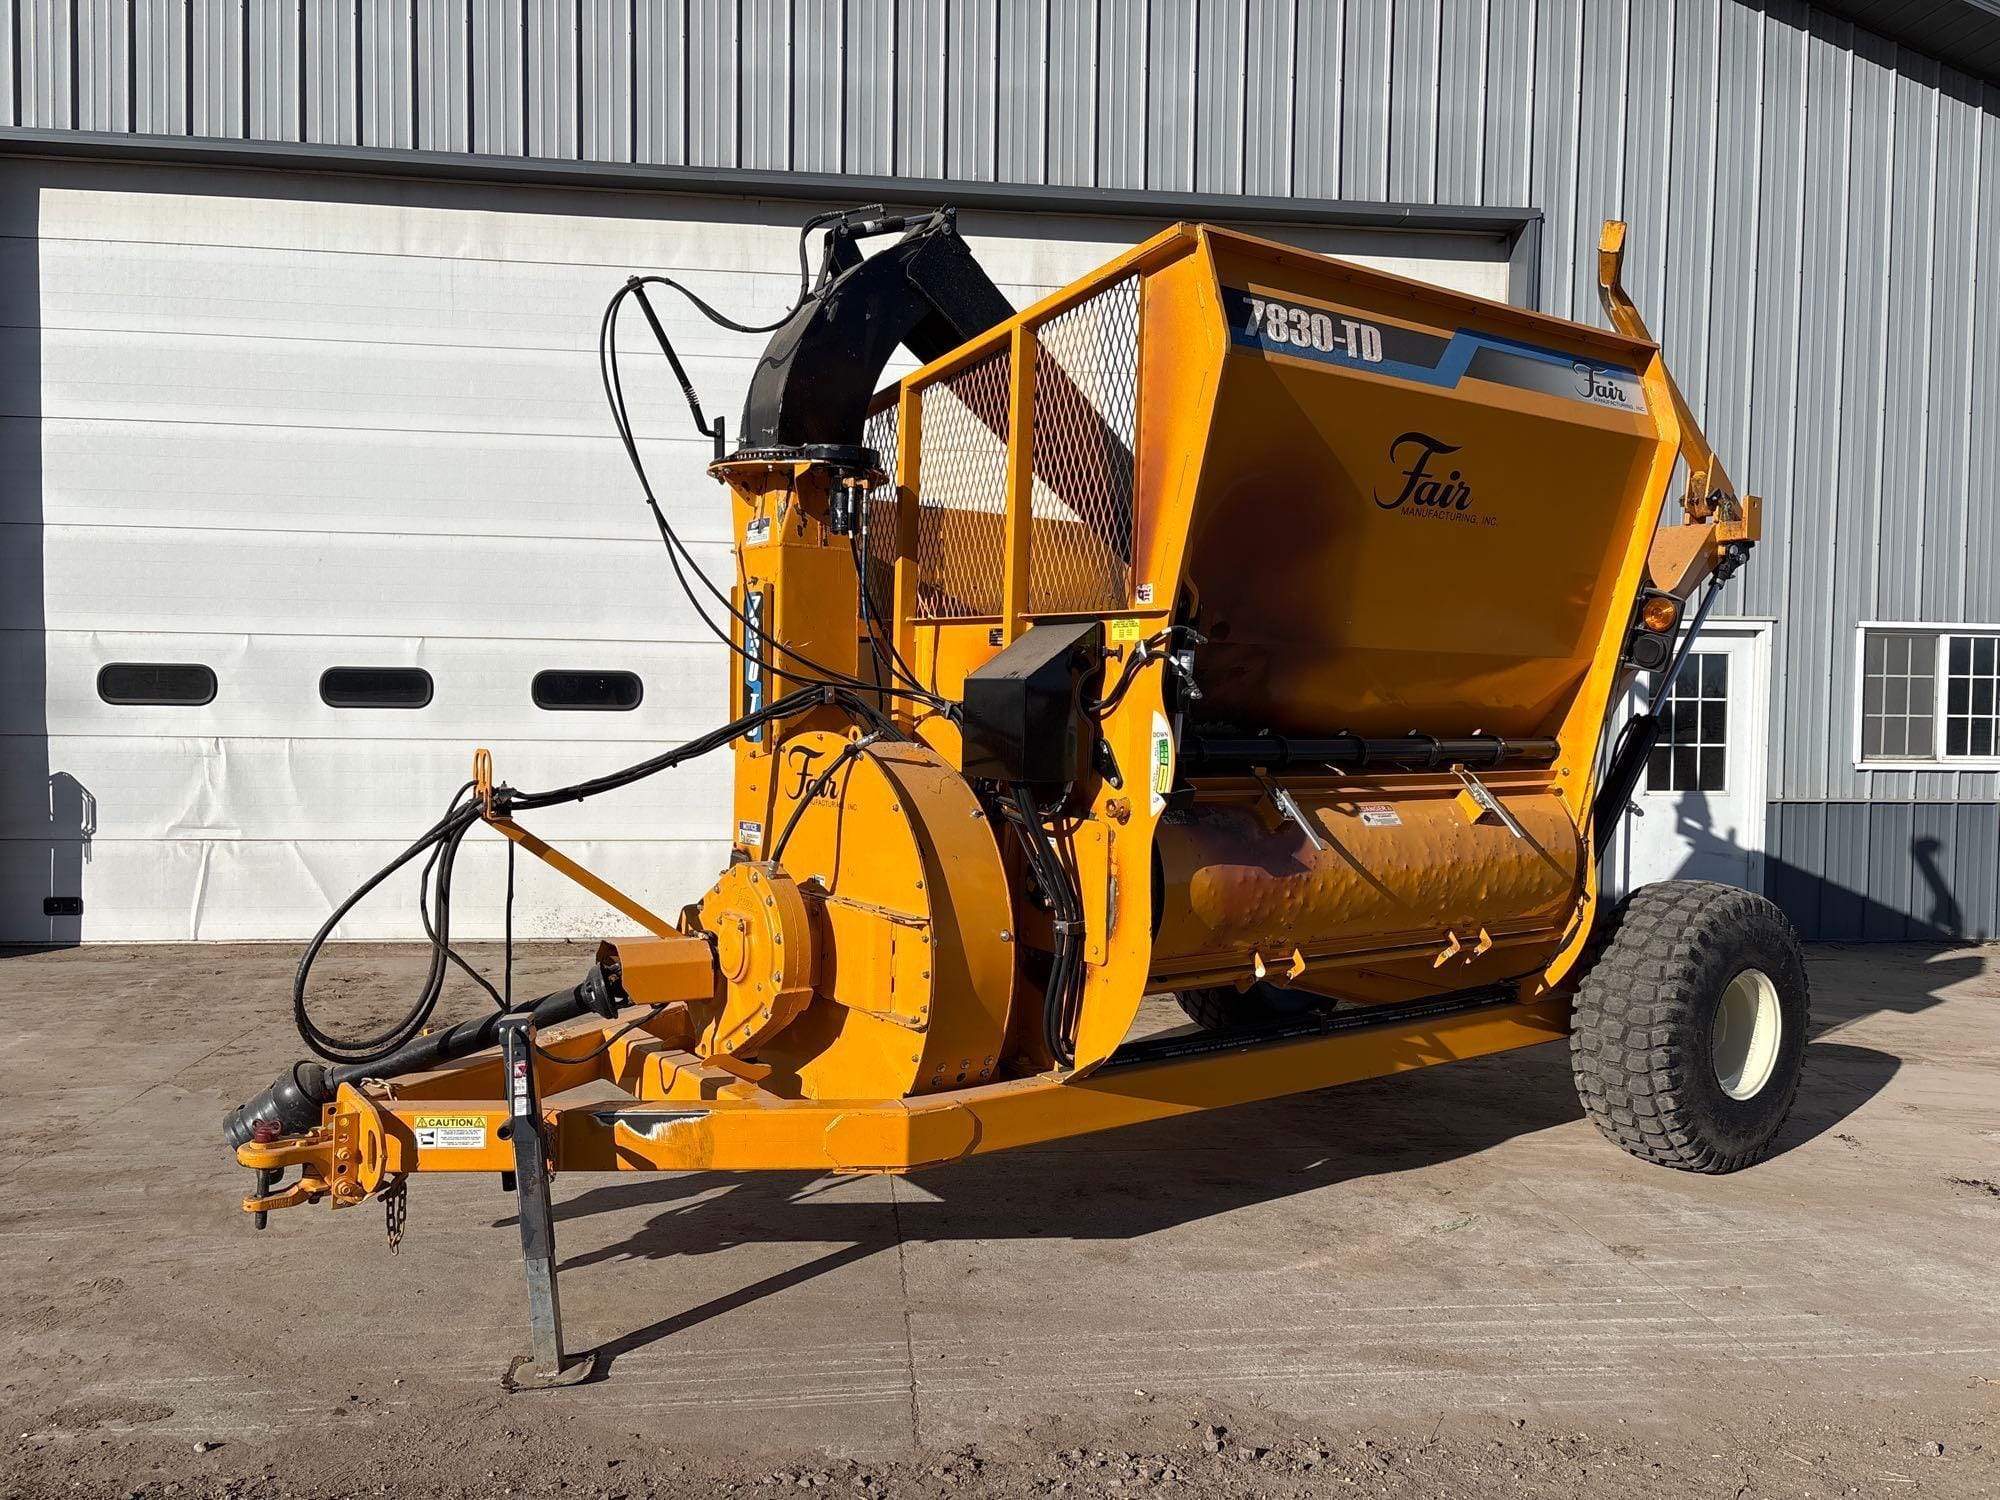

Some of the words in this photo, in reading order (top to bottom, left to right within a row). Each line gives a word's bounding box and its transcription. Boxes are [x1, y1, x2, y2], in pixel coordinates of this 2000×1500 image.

[1243, 297, 1383, 363] 7830-TD
[1573, 361, 1627, 402] Fair
[1373, 431, 1474, 511] Fair
[428, 1118, 473, 1127] CAUTION
